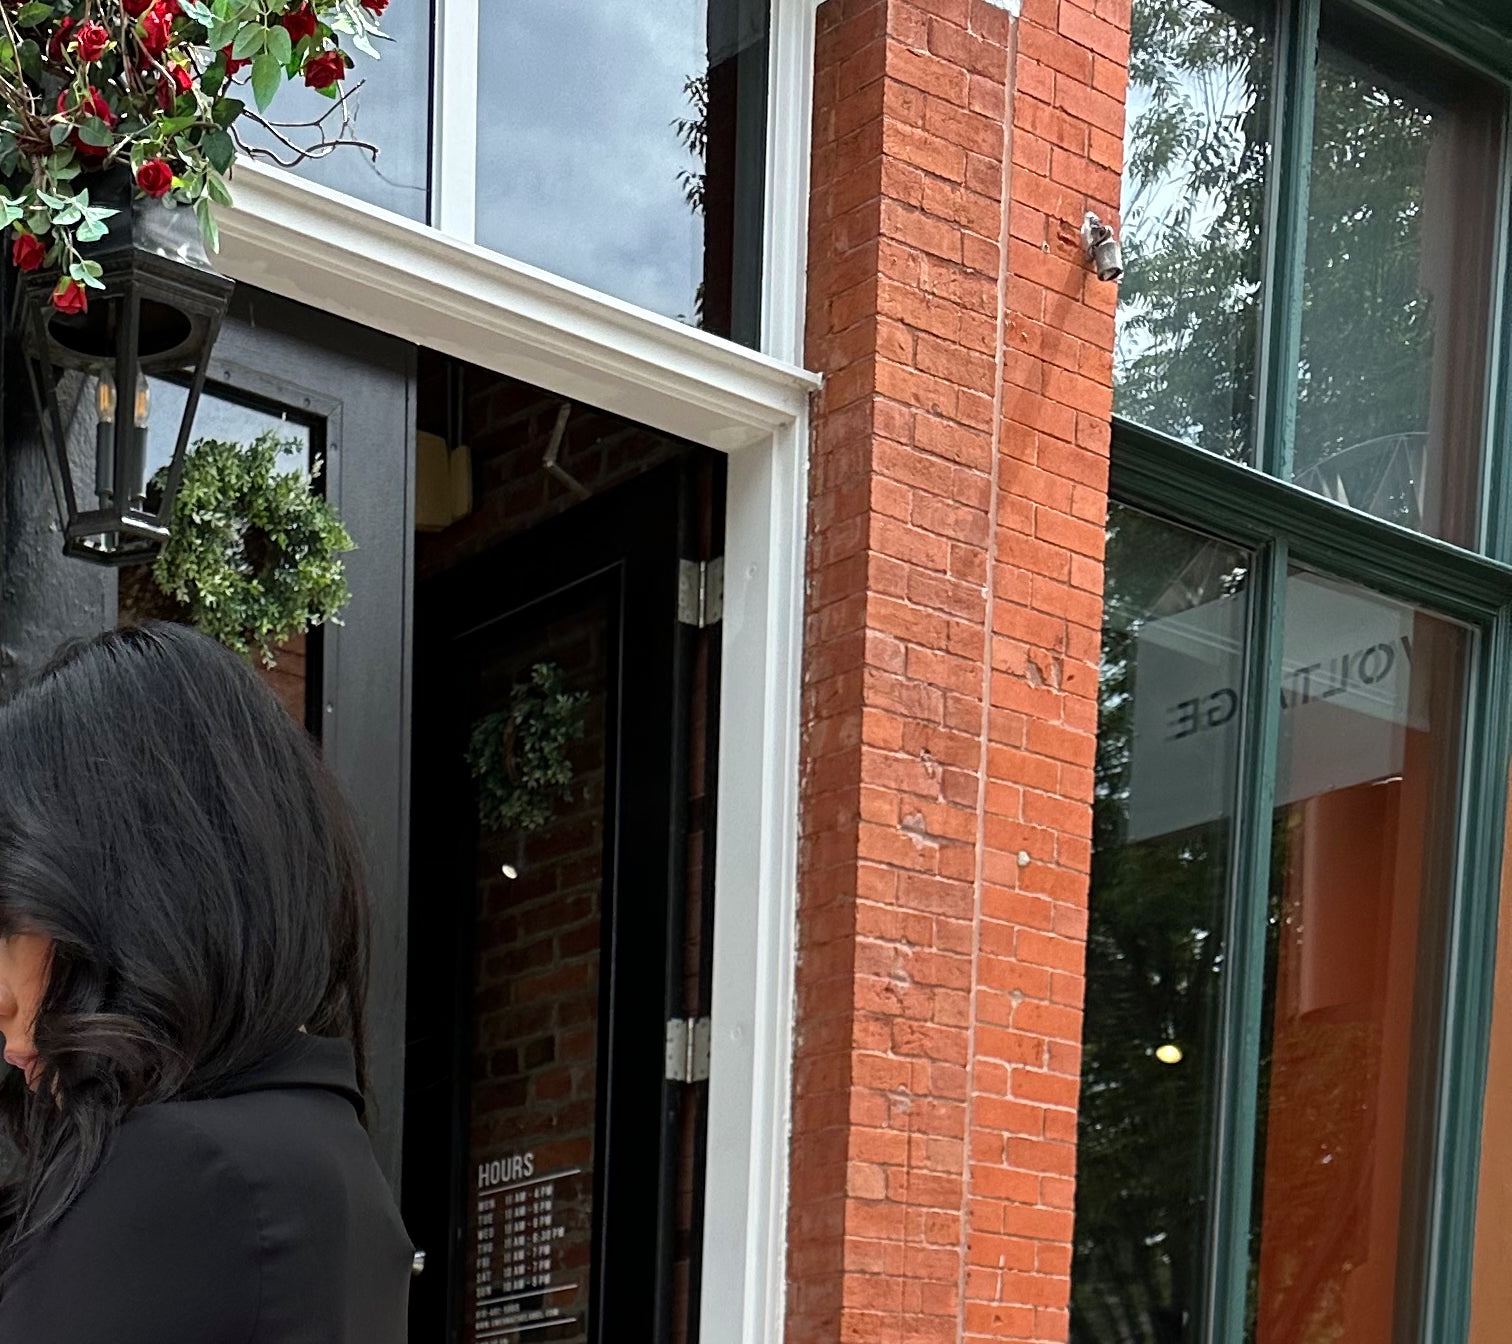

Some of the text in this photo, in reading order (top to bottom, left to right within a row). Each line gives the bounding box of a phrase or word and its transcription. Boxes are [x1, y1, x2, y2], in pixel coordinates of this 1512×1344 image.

[479, 1153, 535, 1188] HOURS
[514, 1190, 526, 1203] AM
[540, 1183, 553, 1197] PM
[514, 1204, 525, 1218] AM
[539, 1198, 552, 1212] PM
[513, 1219, 525, 1233] AM
[539, 1213, 551, 1227] PM
[513, 1233, 525, 1247] AM
[552, 1225, 564, 1239] PM
[513, 1248, 525, 1261] AM
[539, 1243, 551, 1256] PM
[476, 1269, 490, 1283] SAT
[513, 1263, 524, 1276] AM
[538, 1257, 551, 1271] PM
[512, 1277, 524, 1291] AM
[538, 1272, 550, 1286] PM
